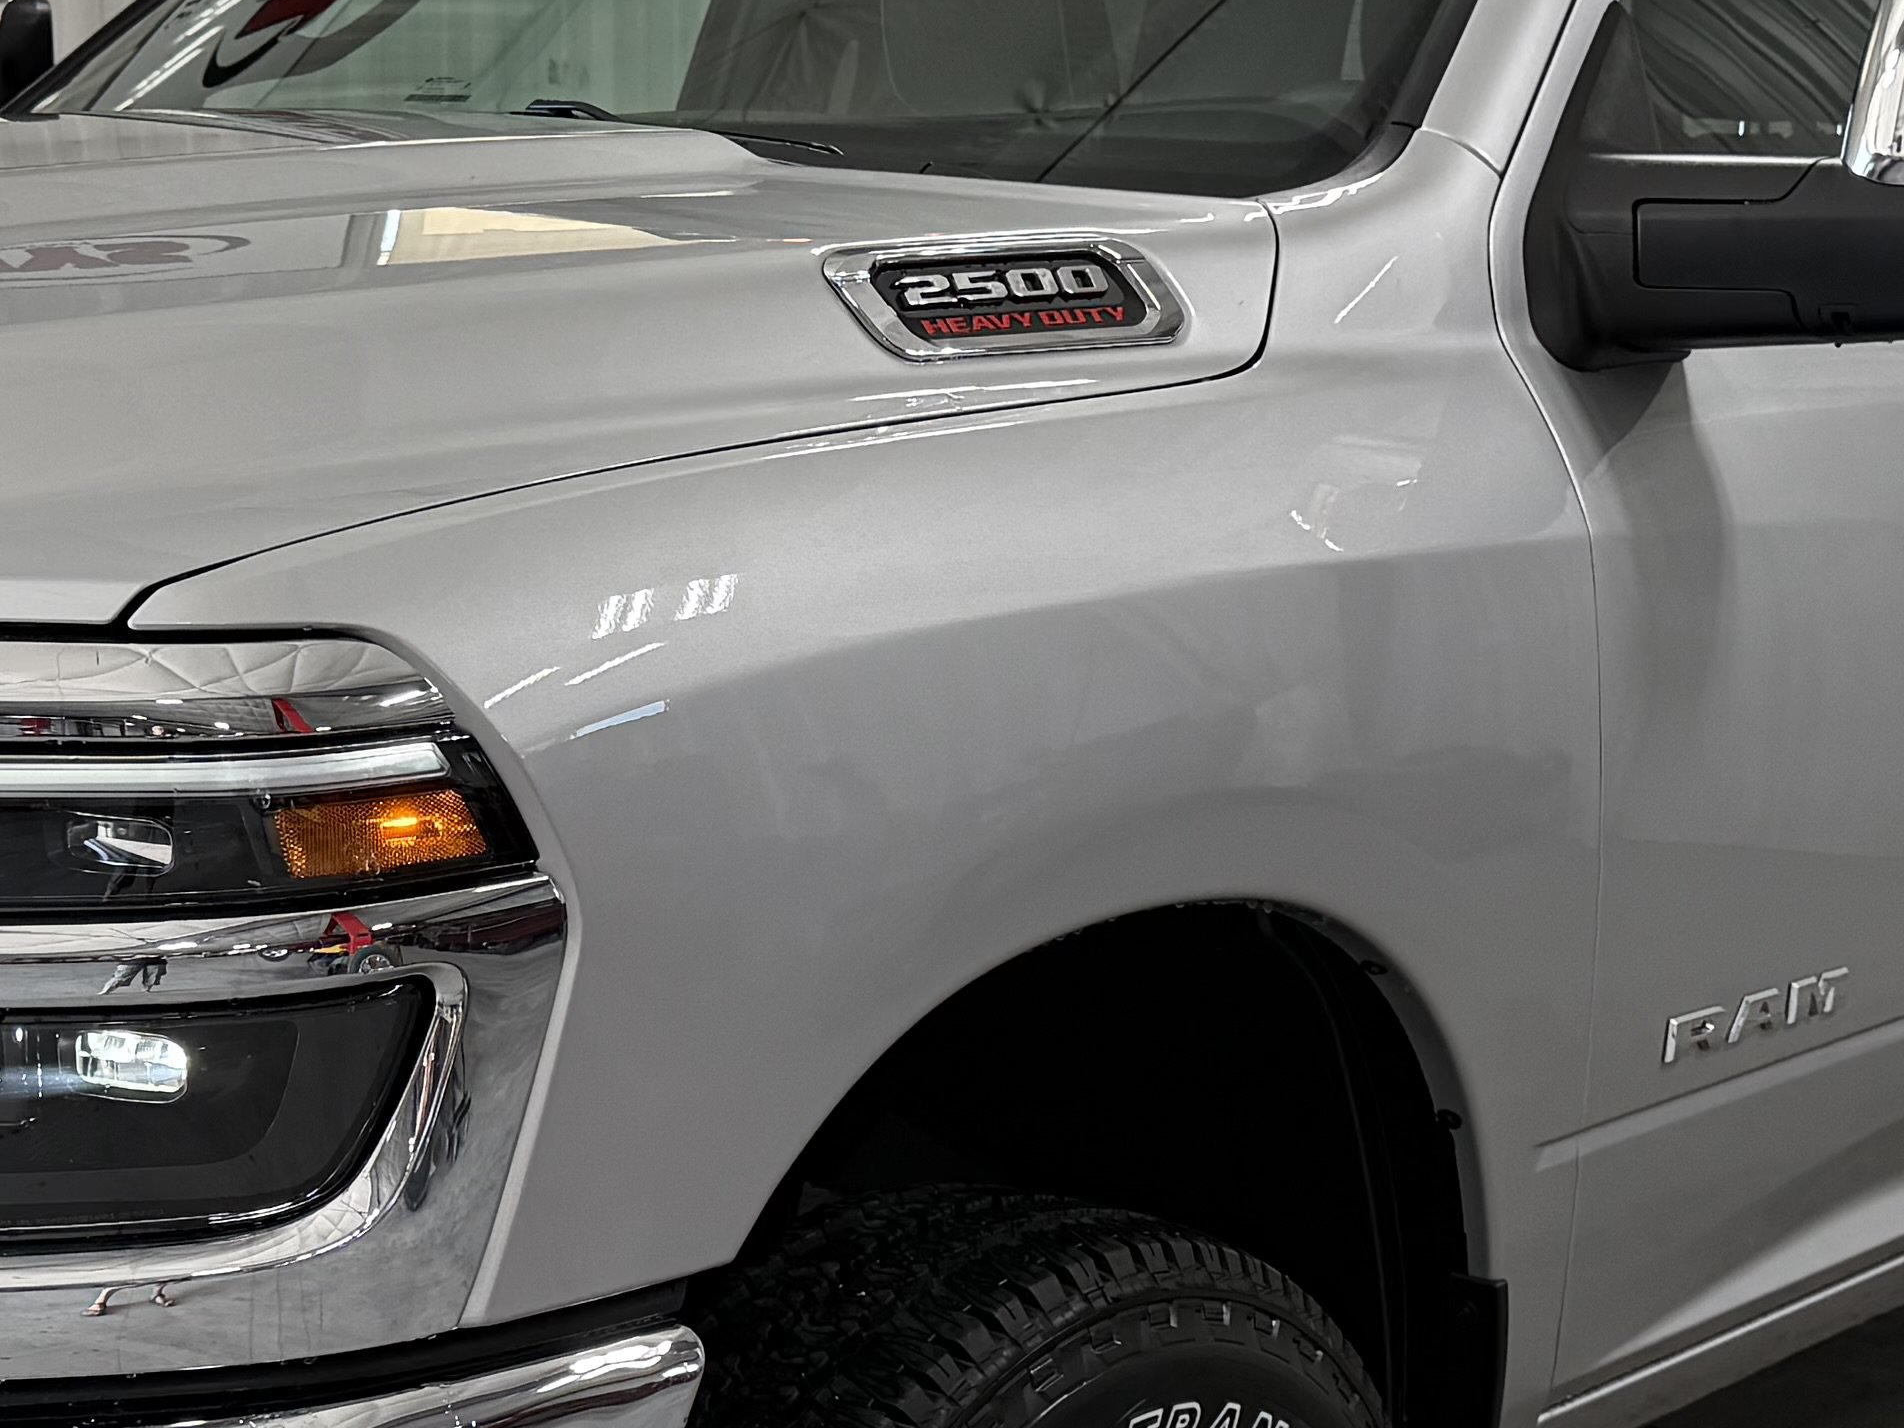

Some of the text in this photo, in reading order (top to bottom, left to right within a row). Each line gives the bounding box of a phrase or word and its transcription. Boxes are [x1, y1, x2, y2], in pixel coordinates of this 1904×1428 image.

[897, 264, 1110, 309] 2500
[922, 307, 1125, 335] HEAVY DUTY
[1660, 966, 1849, 1064] RAM
